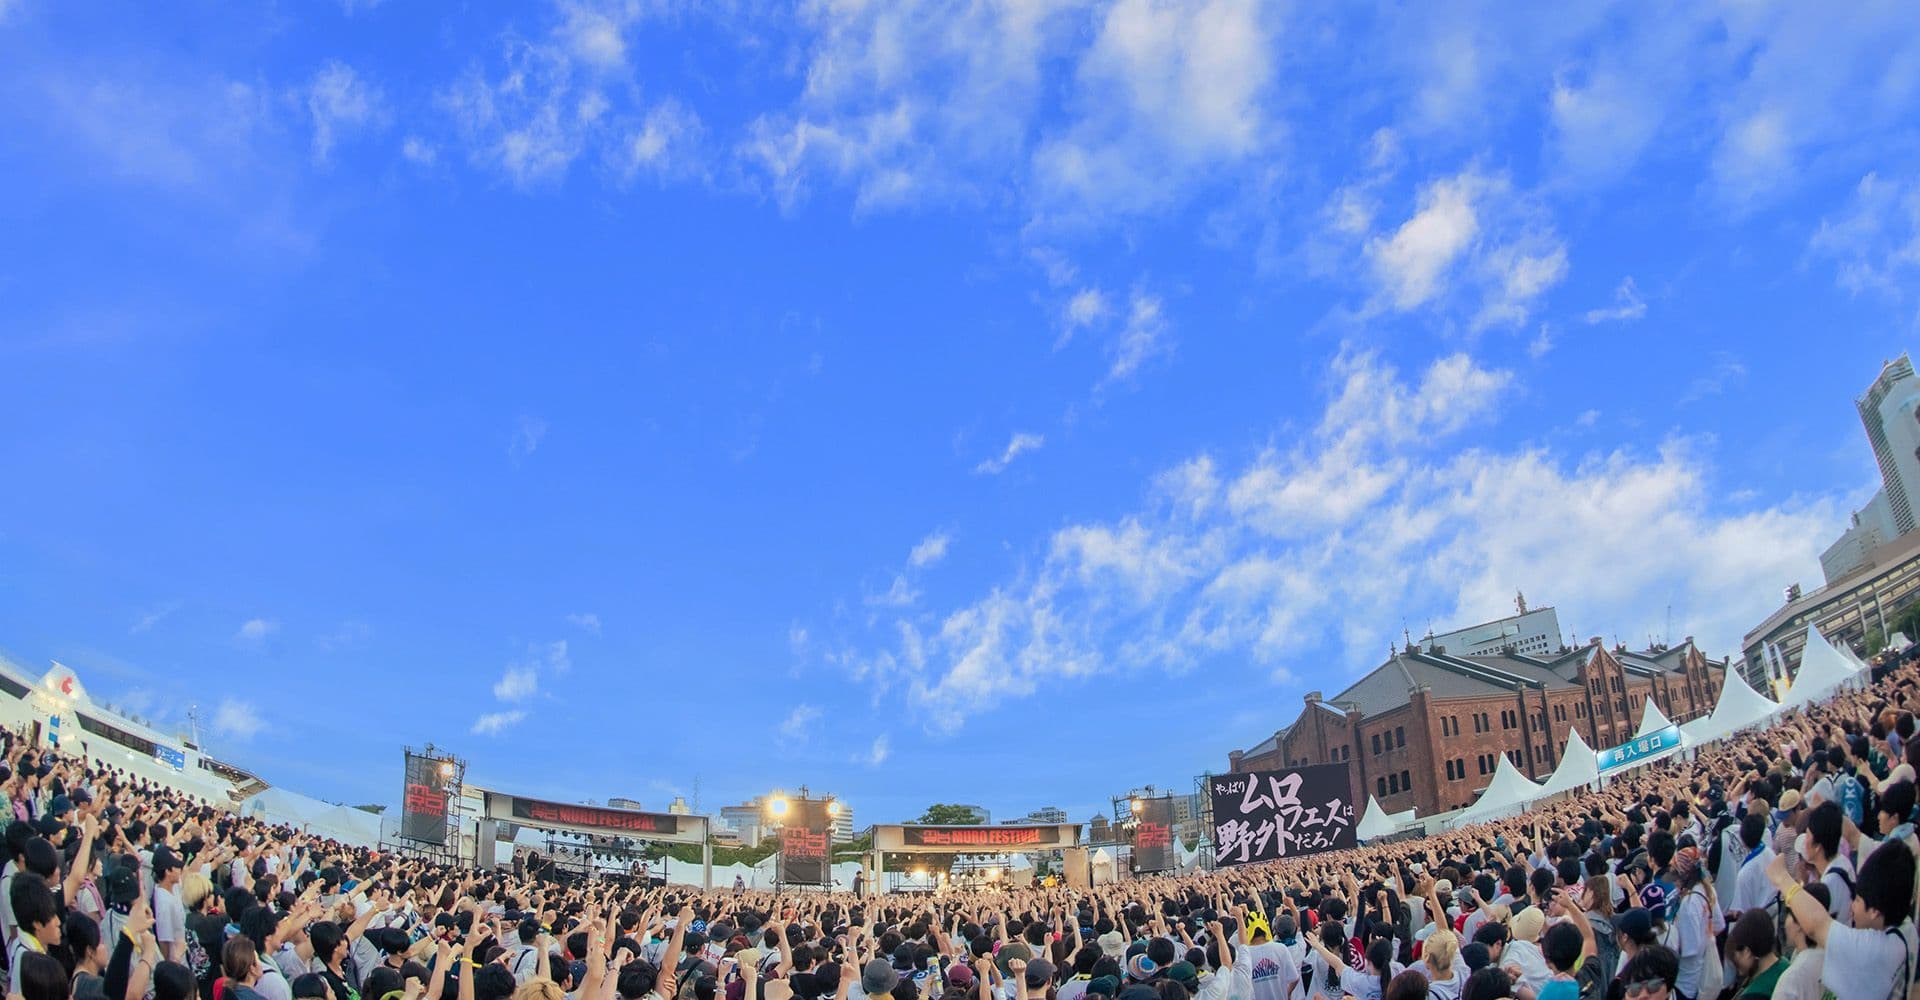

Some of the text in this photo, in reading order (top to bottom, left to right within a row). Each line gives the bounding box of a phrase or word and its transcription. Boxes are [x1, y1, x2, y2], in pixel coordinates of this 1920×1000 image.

[1614, 736, 1662, 762] 再入場口
[1216, 781, 1246, 795] やっぱり
[1240, 772, 1303, 814] ムロ
[559, 806, 597, 825] MURO
[599, 811, 657, 831] FESTIVAL
[952, 829, 988, 844] MURO
[989, 828, 1040, 844] FESTIVAL
[1216, 814, 1294, 862] 野外
